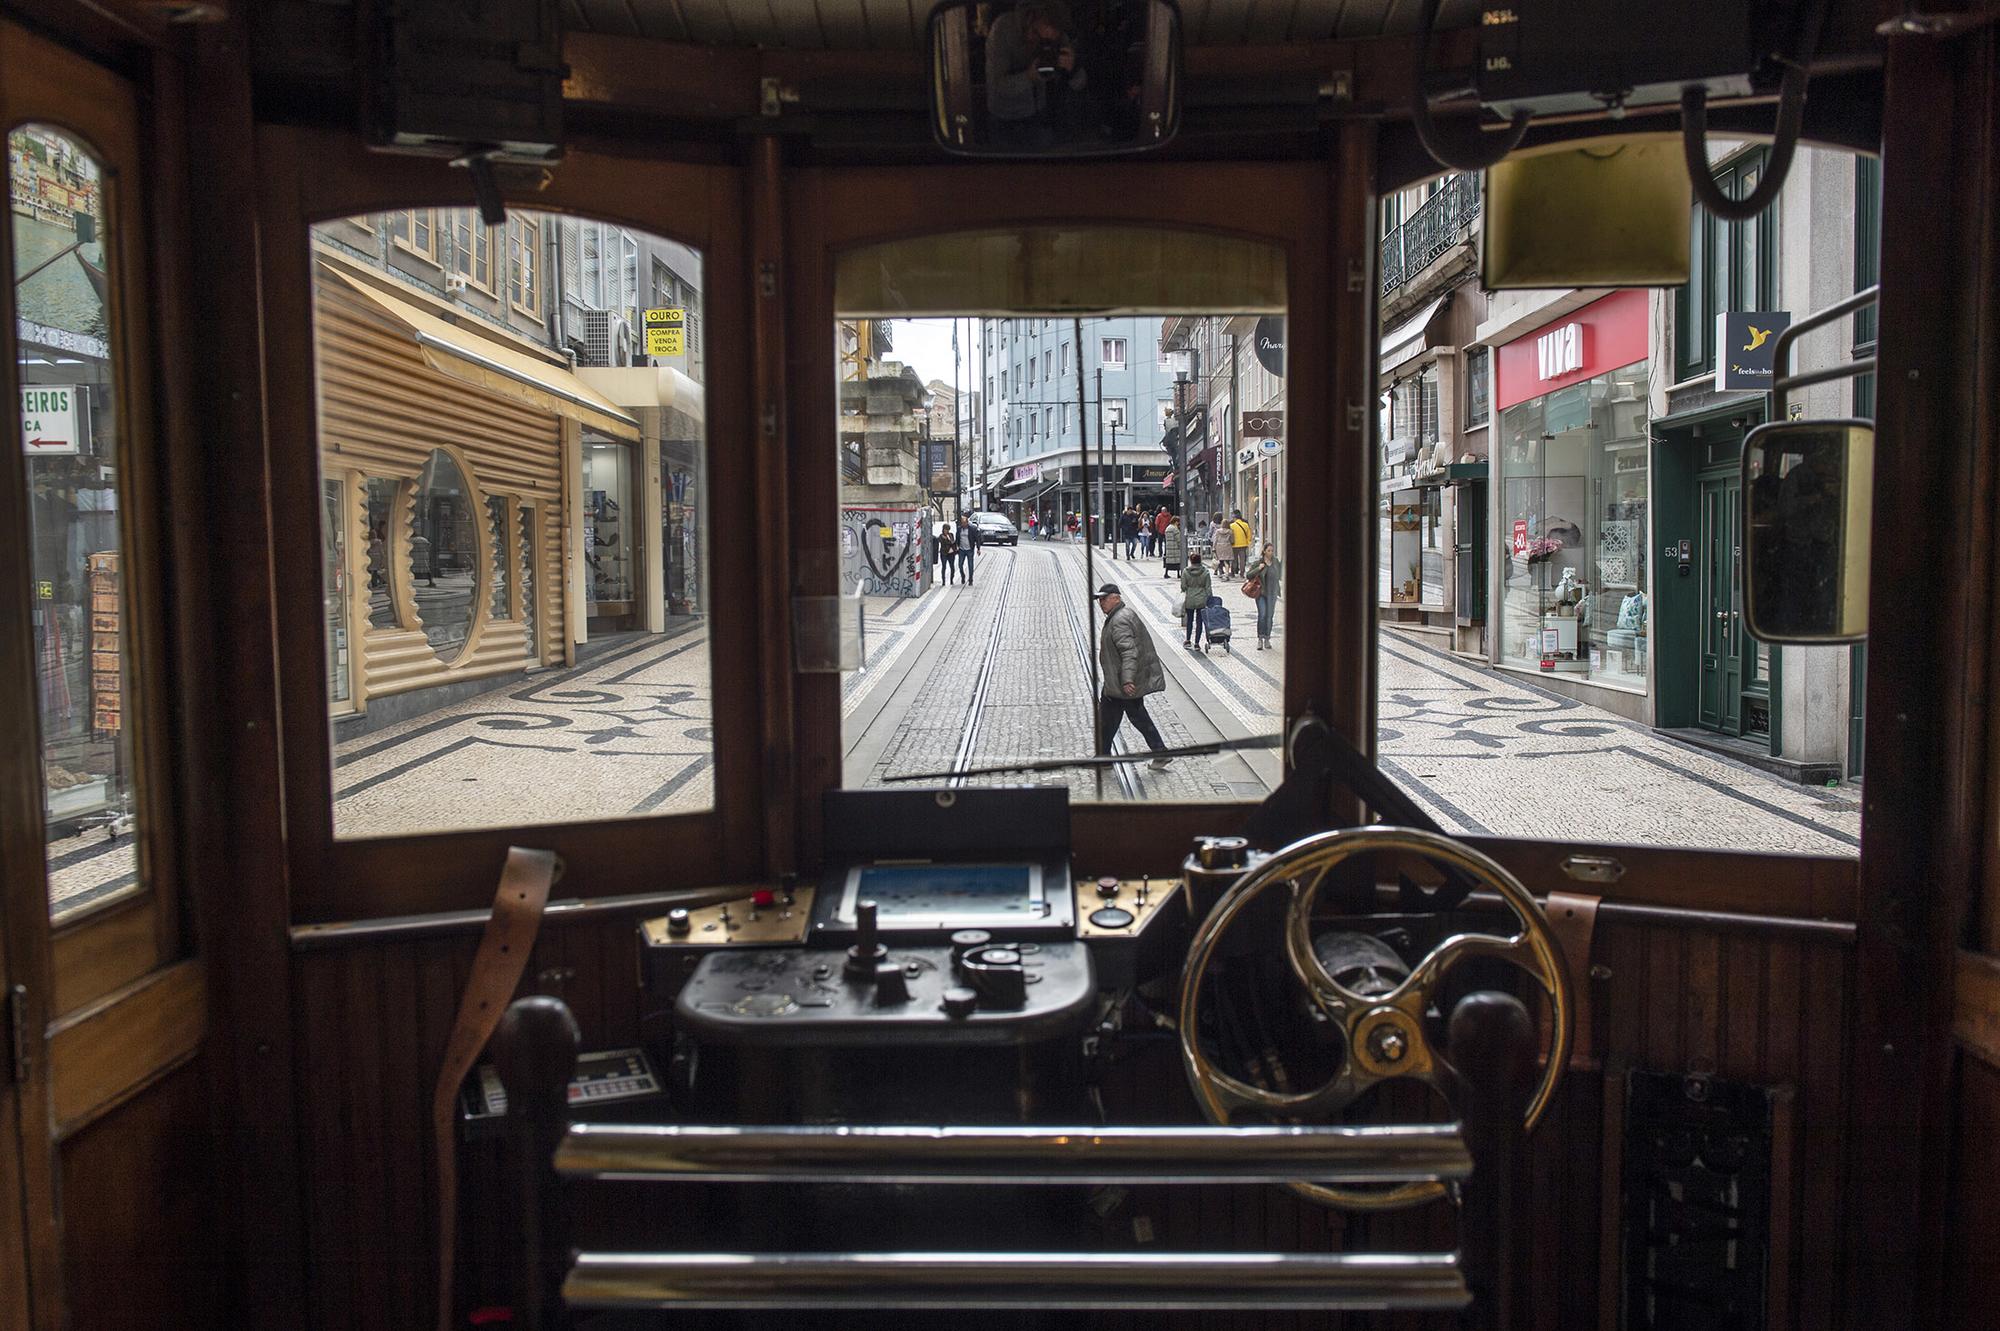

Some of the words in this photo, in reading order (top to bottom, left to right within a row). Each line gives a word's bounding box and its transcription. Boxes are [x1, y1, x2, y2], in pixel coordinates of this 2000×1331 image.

[650, 311, 680, 321] OURO
[654, 345, 678, 353] TROCA
[1664, 546, 1678, 557] 53
